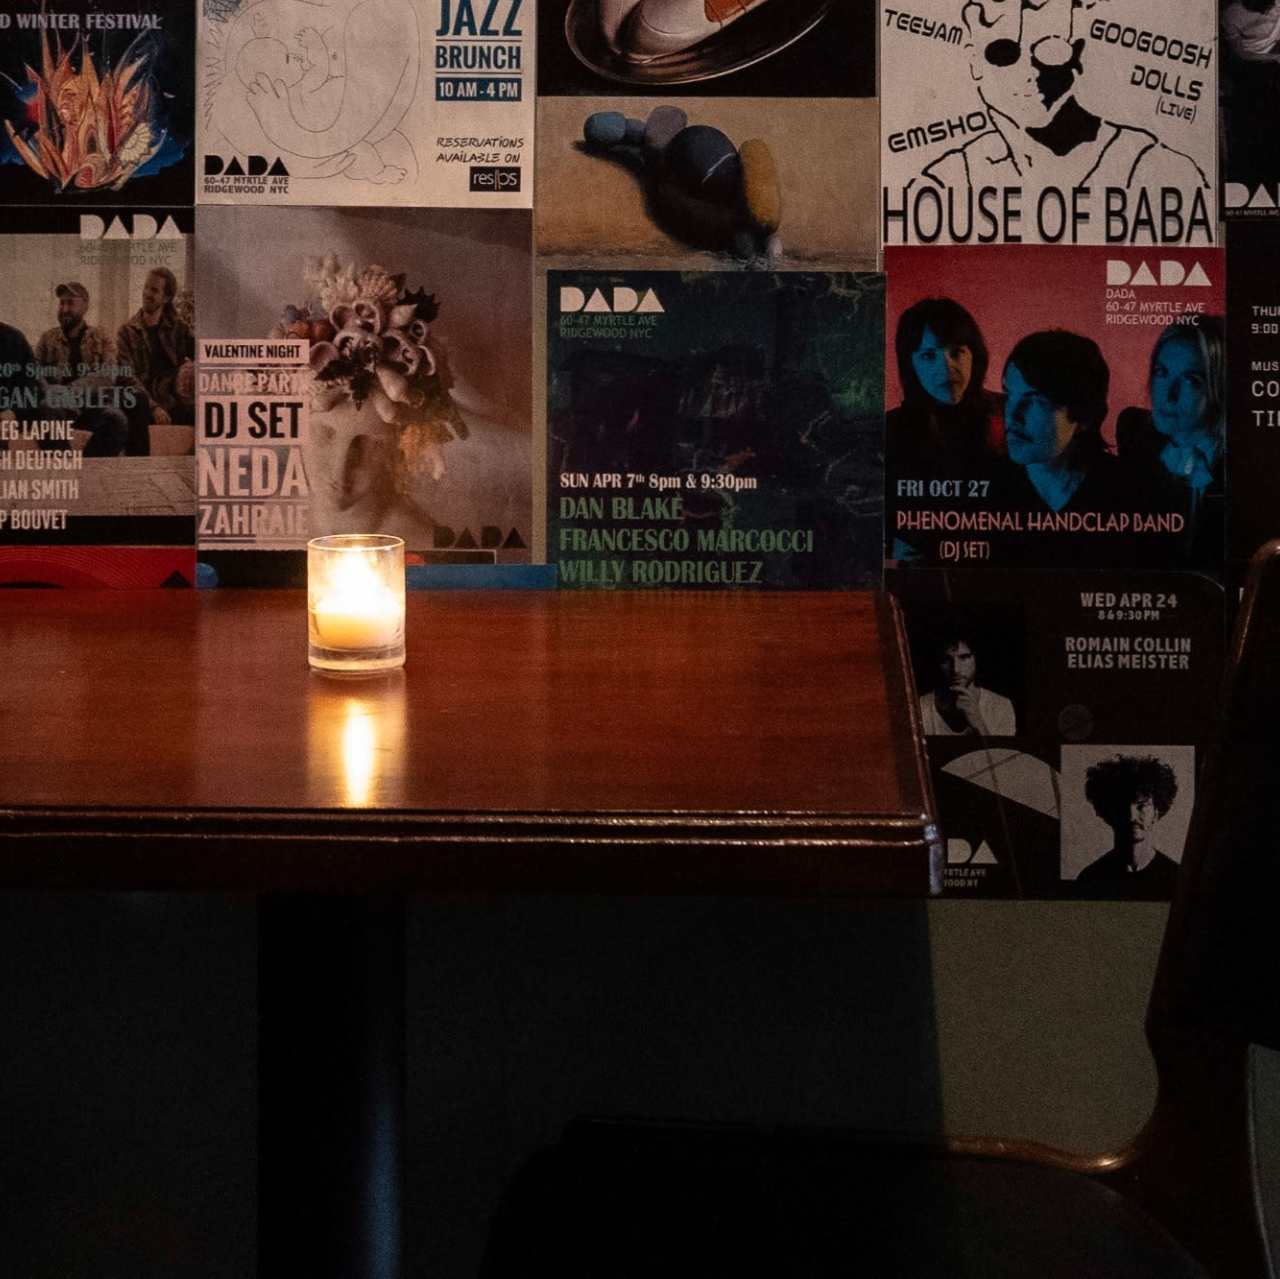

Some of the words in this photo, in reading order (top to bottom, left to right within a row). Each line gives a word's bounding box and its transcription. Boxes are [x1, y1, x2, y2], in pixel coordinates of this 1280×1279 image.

[16, 13, 80, 30] WINTER
[86, 13, 163, 30] FESTIVAL
[435, 46, 521, 70] BRUNCH
[1089, 18, 1213, 69] GOOGOOSH
[1130, 66, 1203, 101] DOLLS
[888, 113, 988, 151] EMSHO
[883, 186, 1022, 244] HOUSE
[1036, 186, 1091, 244] OF
[1106, 186, 1214, 244] BABA
[23, 421, 74, 441] LAPINE
[204, 402, 238, 439] DJ
[248, 401, 302, 439] SET
[199, 447, 308, 497] NEDA
[897, 512, 1022, 532] PHENOMENAL
[1028, 512, 1130, 533] HANDCLAP
[1133, 512, 1184, 532] BAND
[1065, 637, 1130, 653] ROMAIN
[1134, 637, 1191, 653] COLLIN
